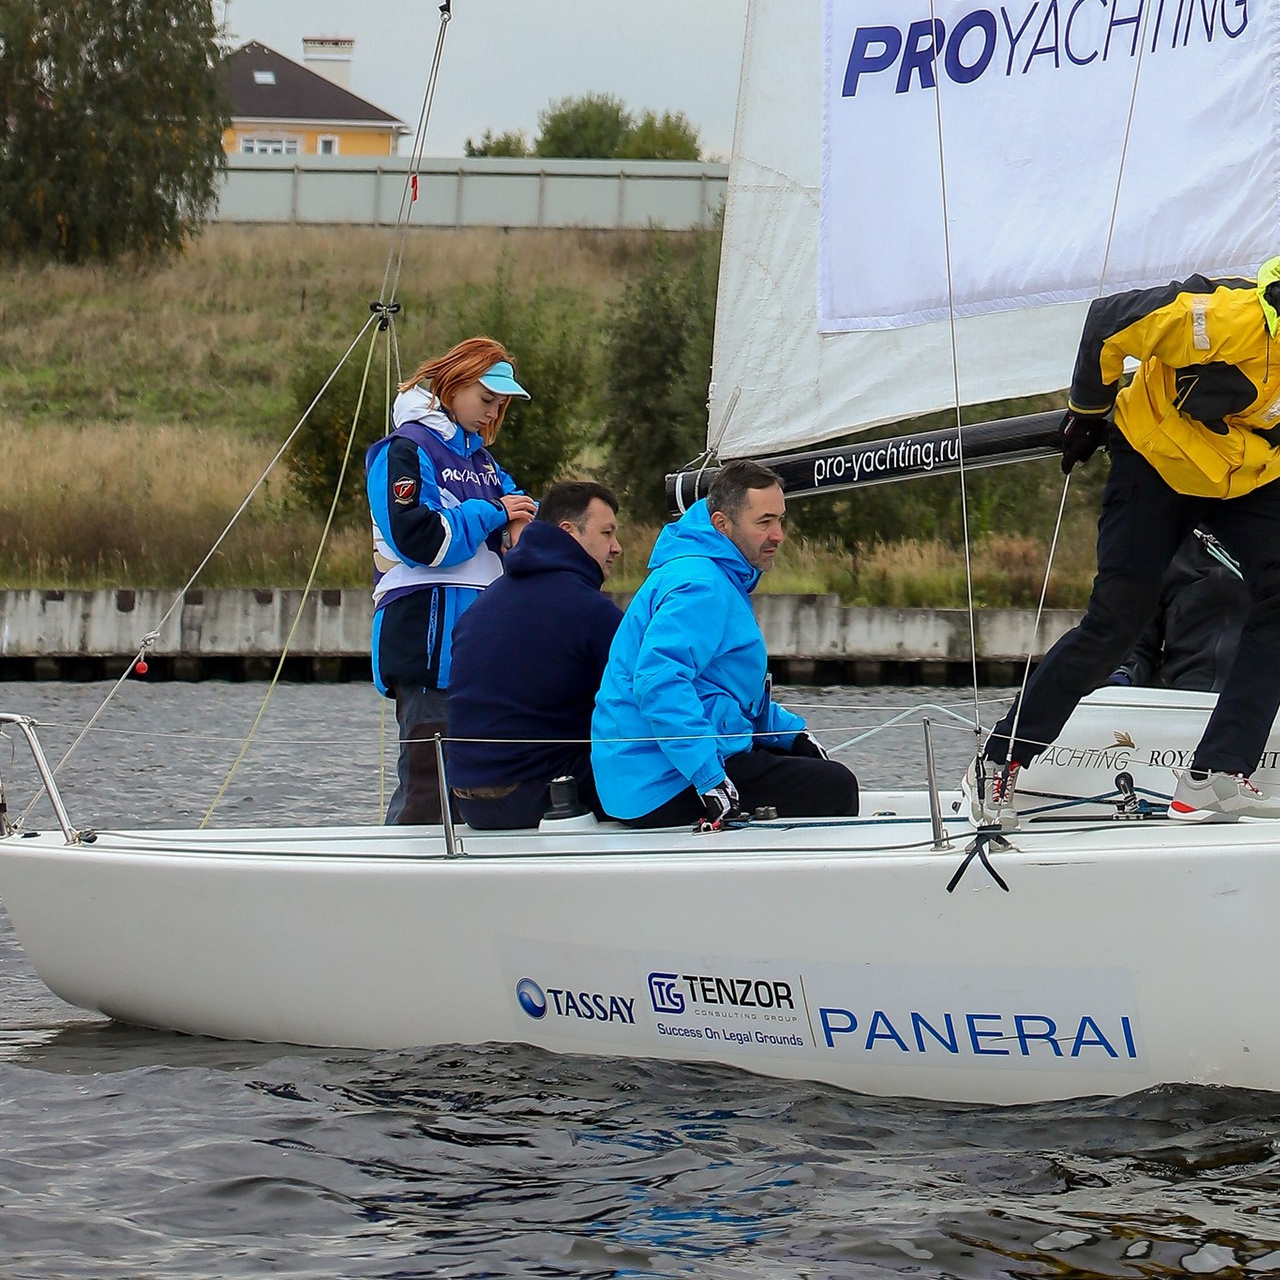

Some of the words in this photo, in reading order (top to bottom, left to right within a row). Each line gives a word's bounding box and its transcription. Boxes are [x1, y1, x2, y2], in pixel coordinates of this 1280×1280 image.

[813, 438, 960, 487] pro-yachting.ru
[547, 988, 636, 1024] TASSAY
[682, 975, 795, 1009] TENZOR
[694, 1009, 757, 1020] CONSULTING
[764, 1014, 798, 1023] GROUP
[819, 1007, 1137, 1058] PANERAI
[657, 1023, 703, 1039] Success
[704, 1027, 721, 1040] On
[722, 1029, 753, 1044] Legal
[755, 1031, 804, 1046] Grounds
